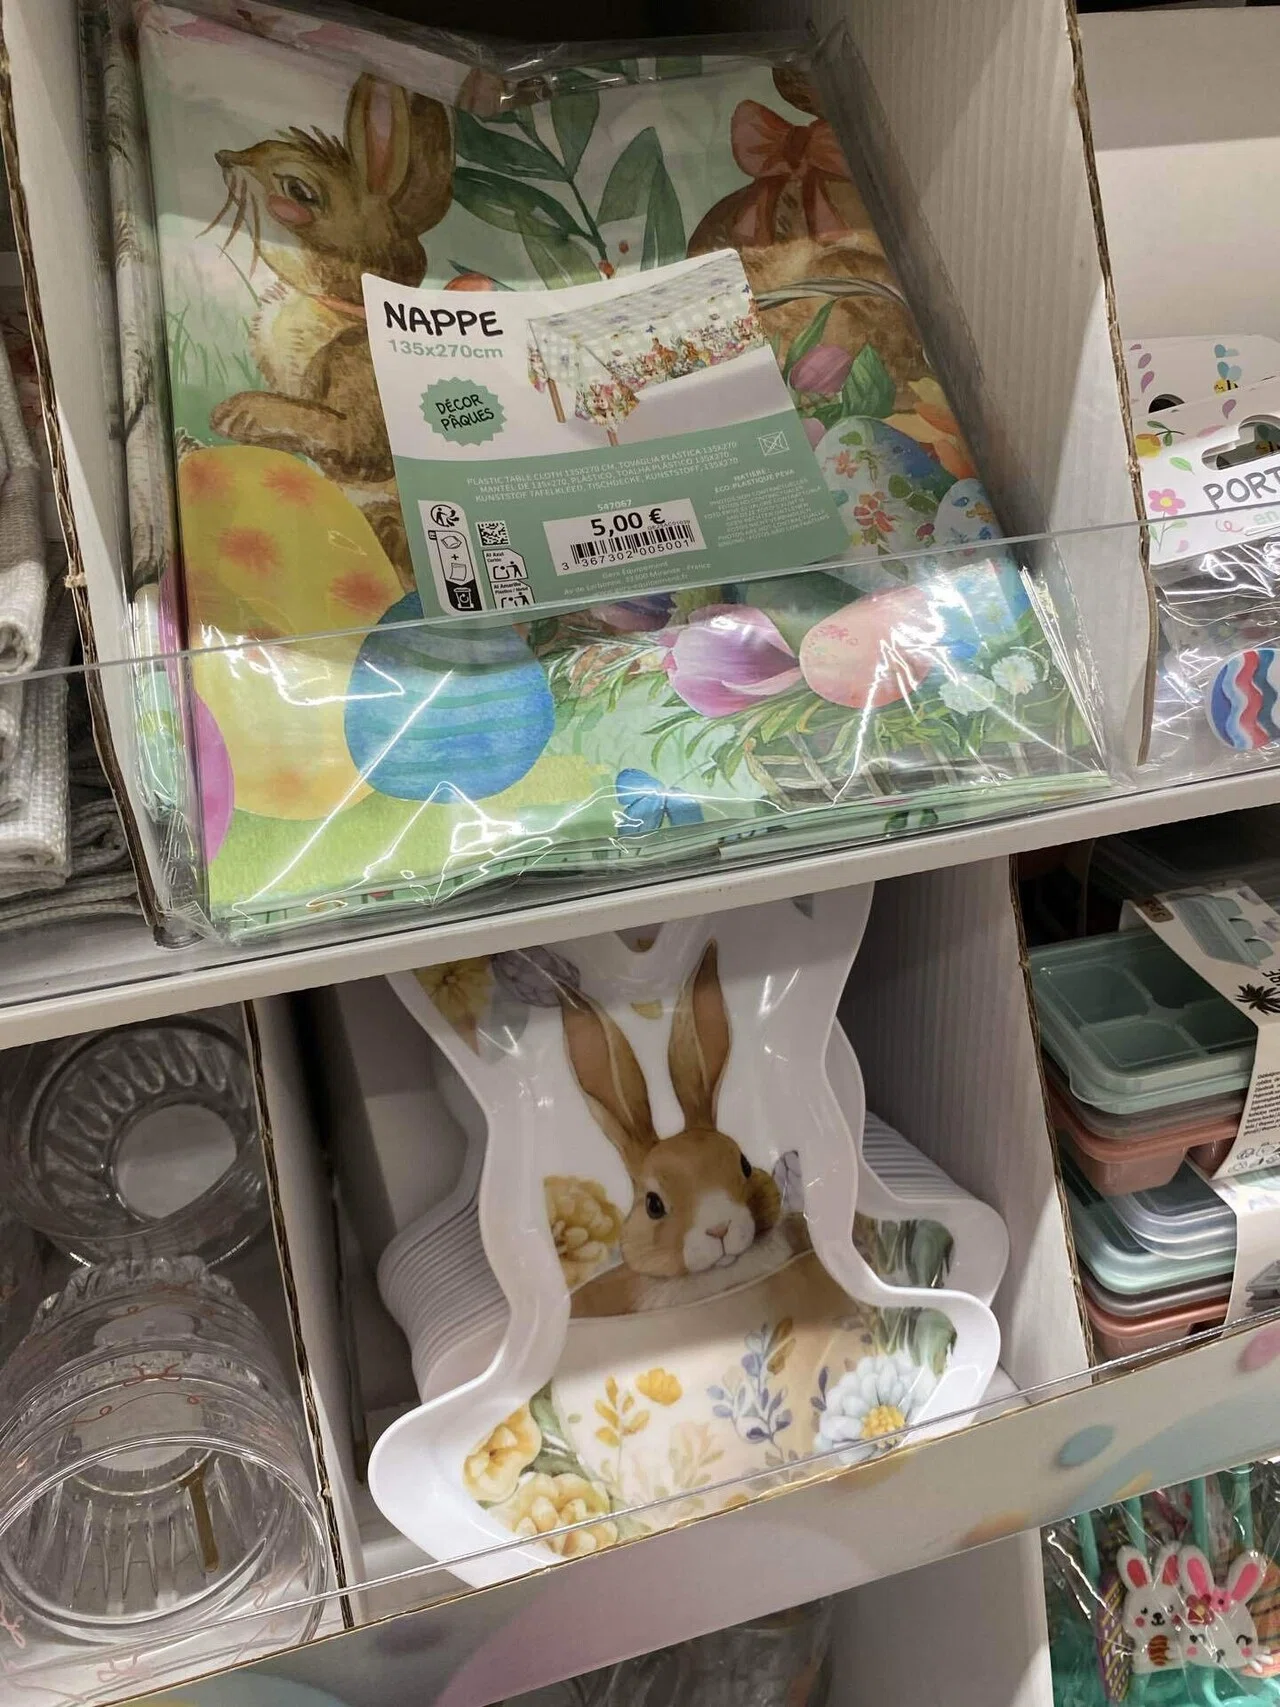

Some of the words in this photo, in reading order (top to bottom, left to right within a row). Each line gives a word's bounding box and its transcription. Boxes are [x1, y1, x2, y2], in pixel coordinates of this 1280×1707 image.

[383, 301, 503, 337] NAPPE
[388, 339, 503, 358] 135x270cm
[435, 394, 483, 415] DÉCOR
[441, 408, 494, 431] PÂQUES
[467, 477, 503, 486] PLASTIC
[505, 474, 531, 483] TABLE
[534, 471, 562, 480] CLOTH
[619, 456, 660, 469] TOVAGLIA
[480, 484, 515, 493] MANTEL
[598, 499, 632, 511] 547067
[590, 512, 643, 537] 5,00
[649, 508, 666, 525] €
[562, 562, 570, 571] 3
[582, 552, 633, 567] 367302
[639, 540, 690, 556] 005001
